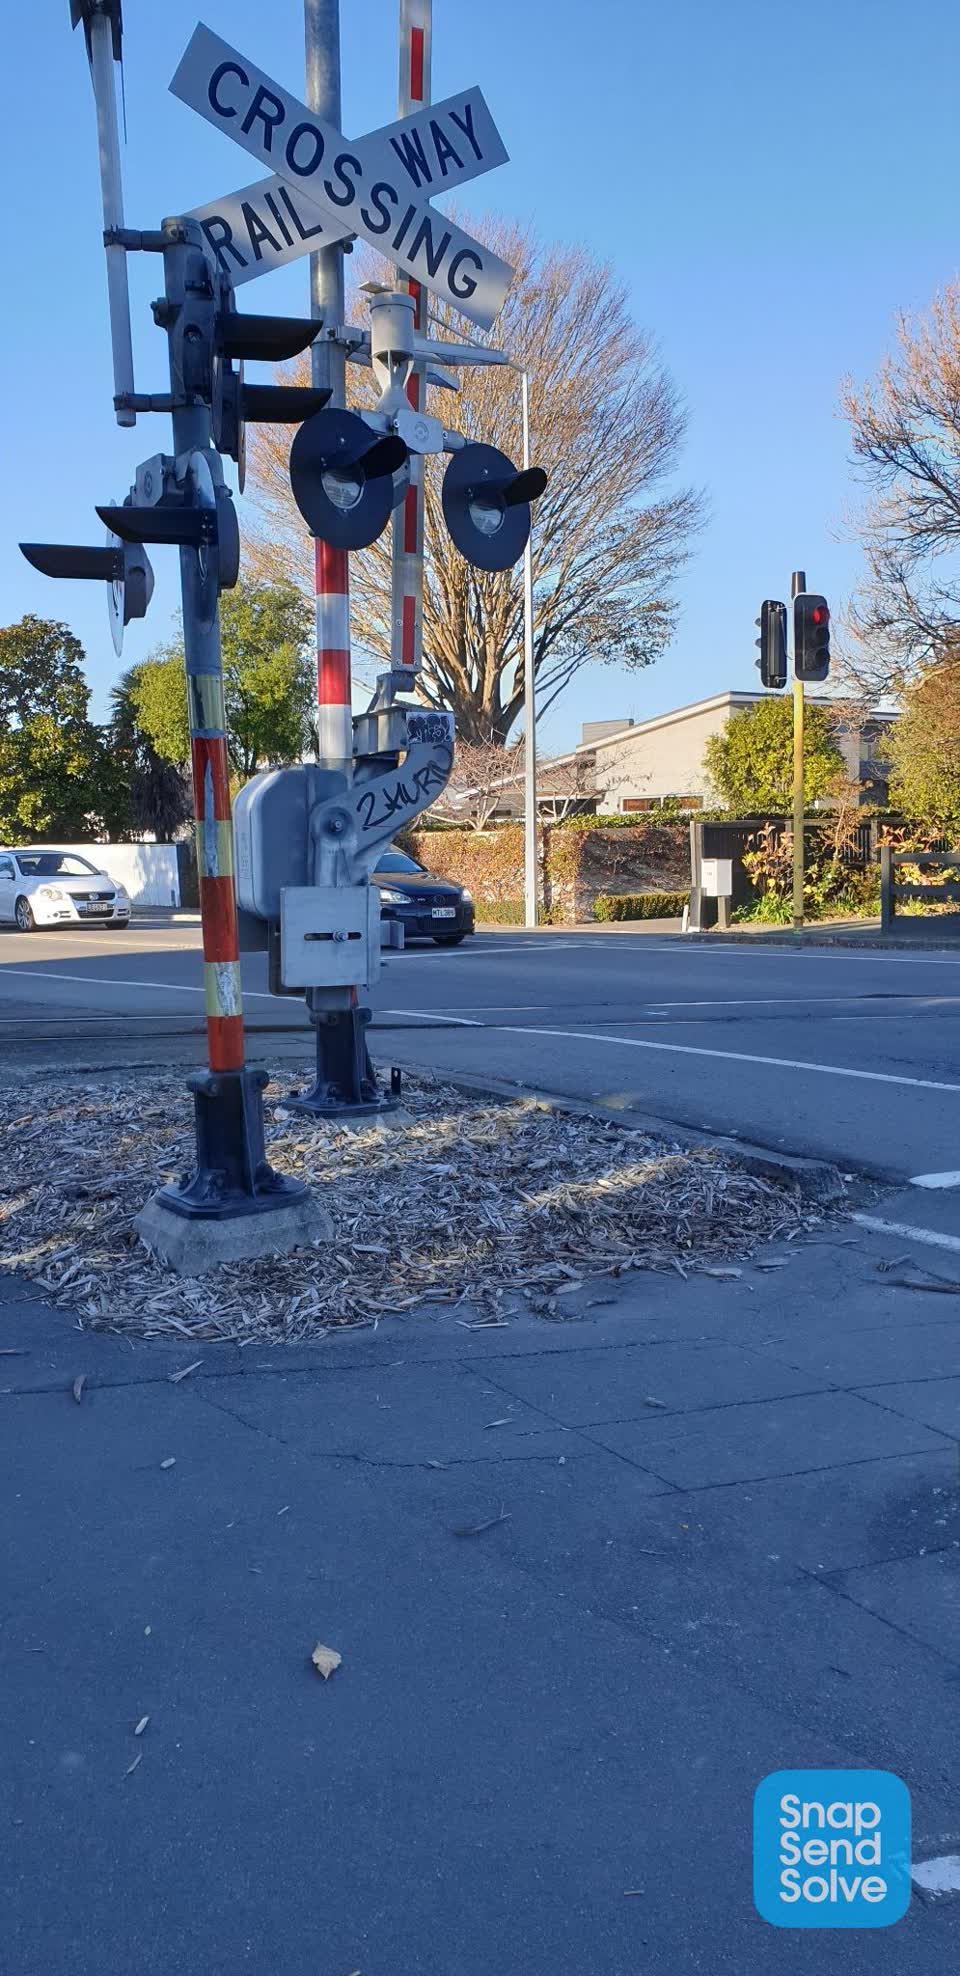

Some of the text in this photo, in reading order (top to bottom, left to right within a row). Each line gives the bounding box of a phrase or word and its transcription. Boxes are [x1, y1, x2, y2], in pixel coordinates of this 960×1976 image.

[200, 104, 483, 273] RAIL WAY
[207, 61, 483, 299] CROSSING
